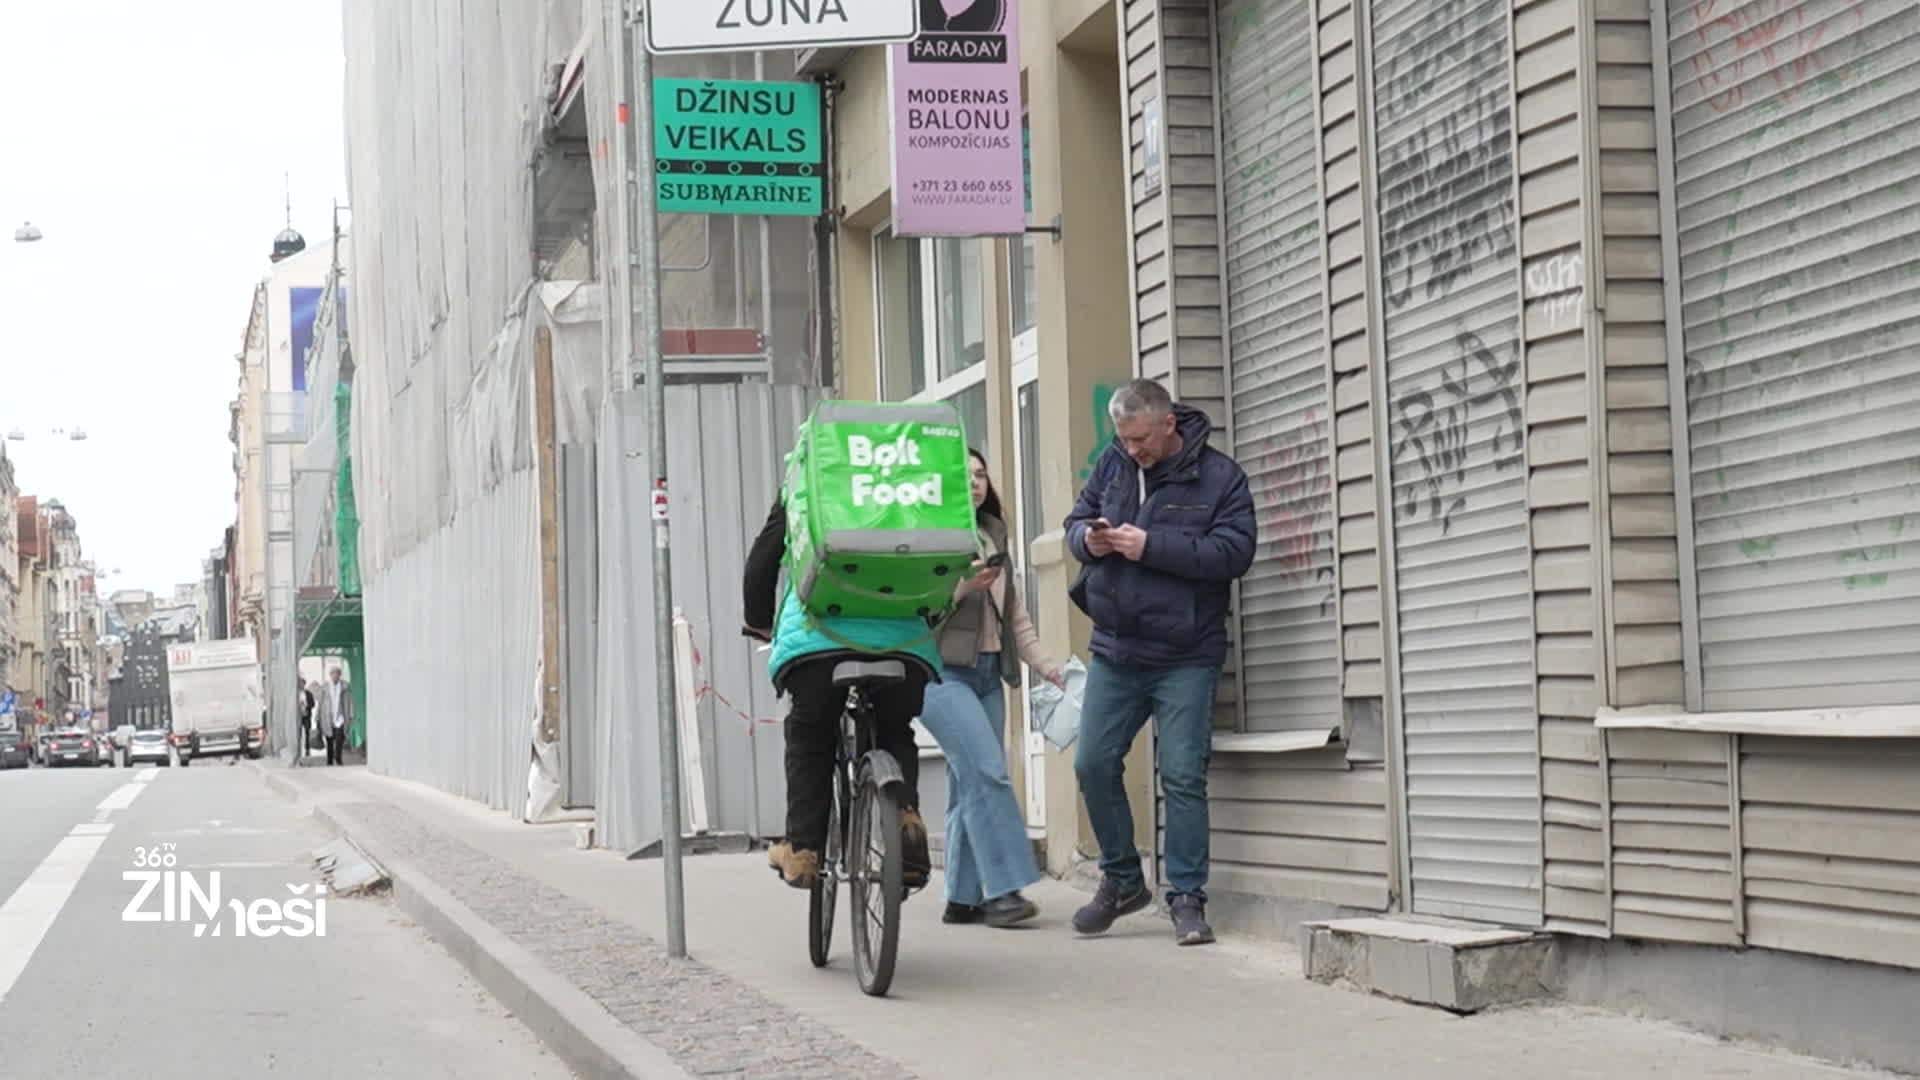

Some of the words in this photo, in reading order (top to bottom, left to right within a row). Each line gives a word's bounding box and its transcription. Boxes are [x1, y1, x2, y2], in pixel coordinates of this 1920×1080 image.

[912, 40, 1003, 58] FARADAY
[676, 82, 795, 116] DŽINSU
[908, 89, 1009, 104] MODERNAS
[908, 108, 1011, 130] BALONU
[665, 125, 806, 153] VEIKALS
[909, 133, 1011, 149] KOMPOZĪCIJAS
[659, 182, 813, 205] SUBMARĪNE
[912, 180, 939, 192] +371
[943, 180, 957, 192] 23
[961, 180, 986, 192] 660
[989, 180, 1012, 192] 655
[848, 435, 922, 474] Bolt
[851, 473, 943, 506] Food
